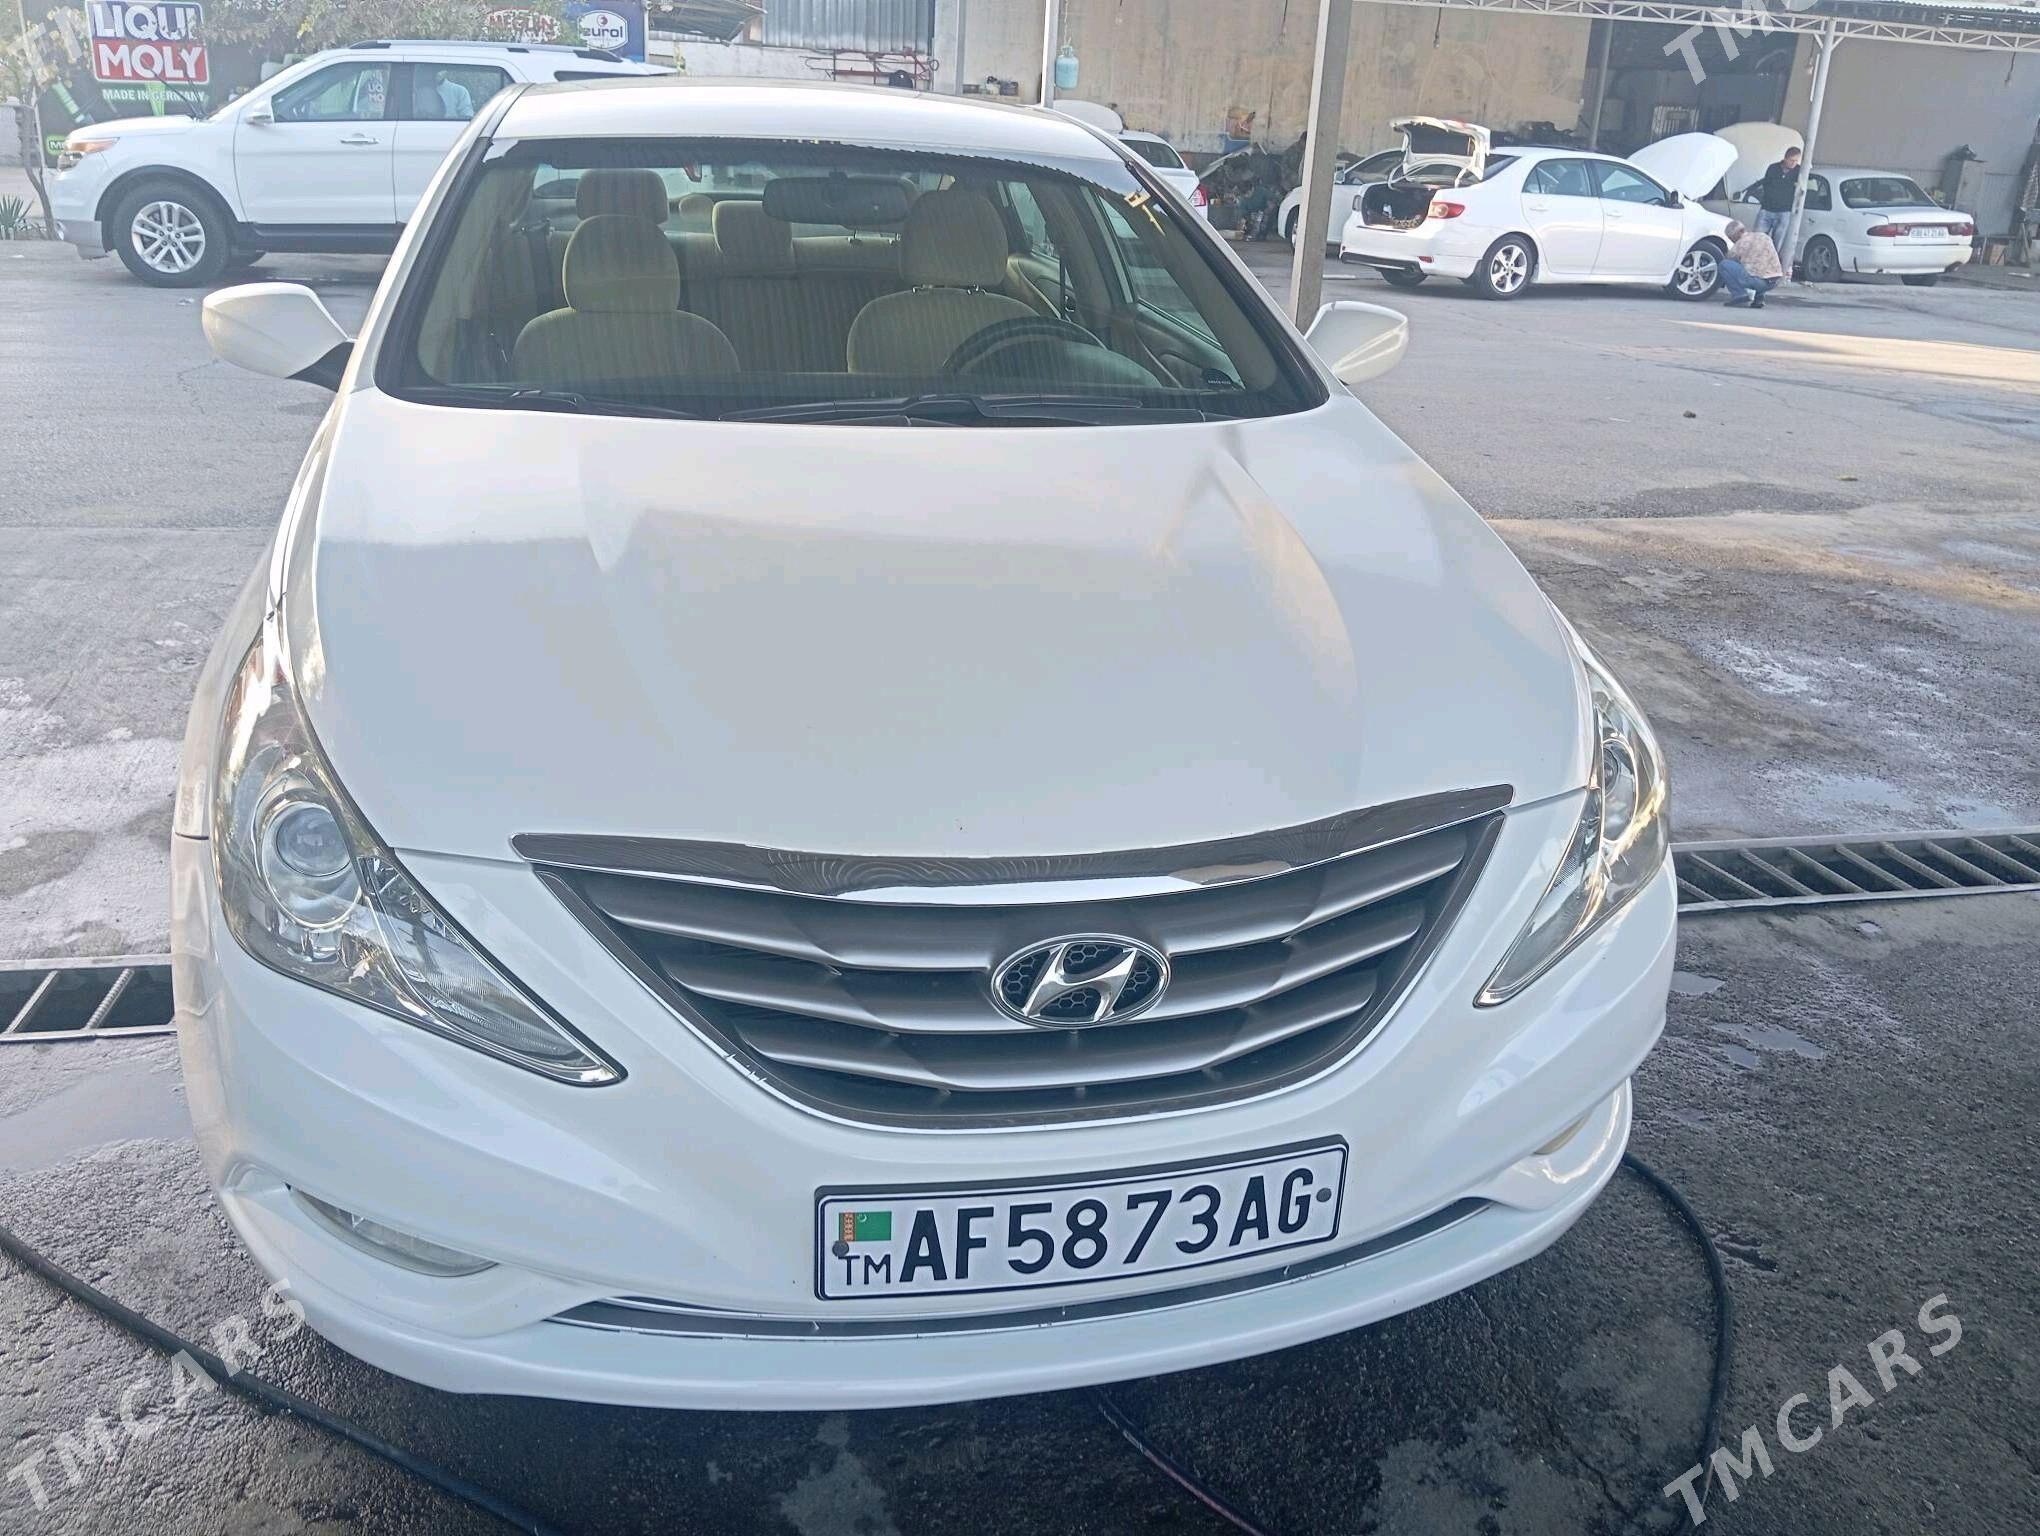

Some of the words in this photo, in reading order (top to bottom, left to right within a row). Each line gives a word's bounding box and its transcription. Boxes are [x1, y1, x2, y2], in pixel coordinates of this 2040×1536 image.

[93, 4, 197, 41] LIQUI
[98, 44, 202, 79] MOLY
[102, 88, 135, 100] MADE
[137, 89, 149, 101] IN
[899, 1167, 1314, 1282] AF5873AG
[838, 1253, 892, 1286] TM
